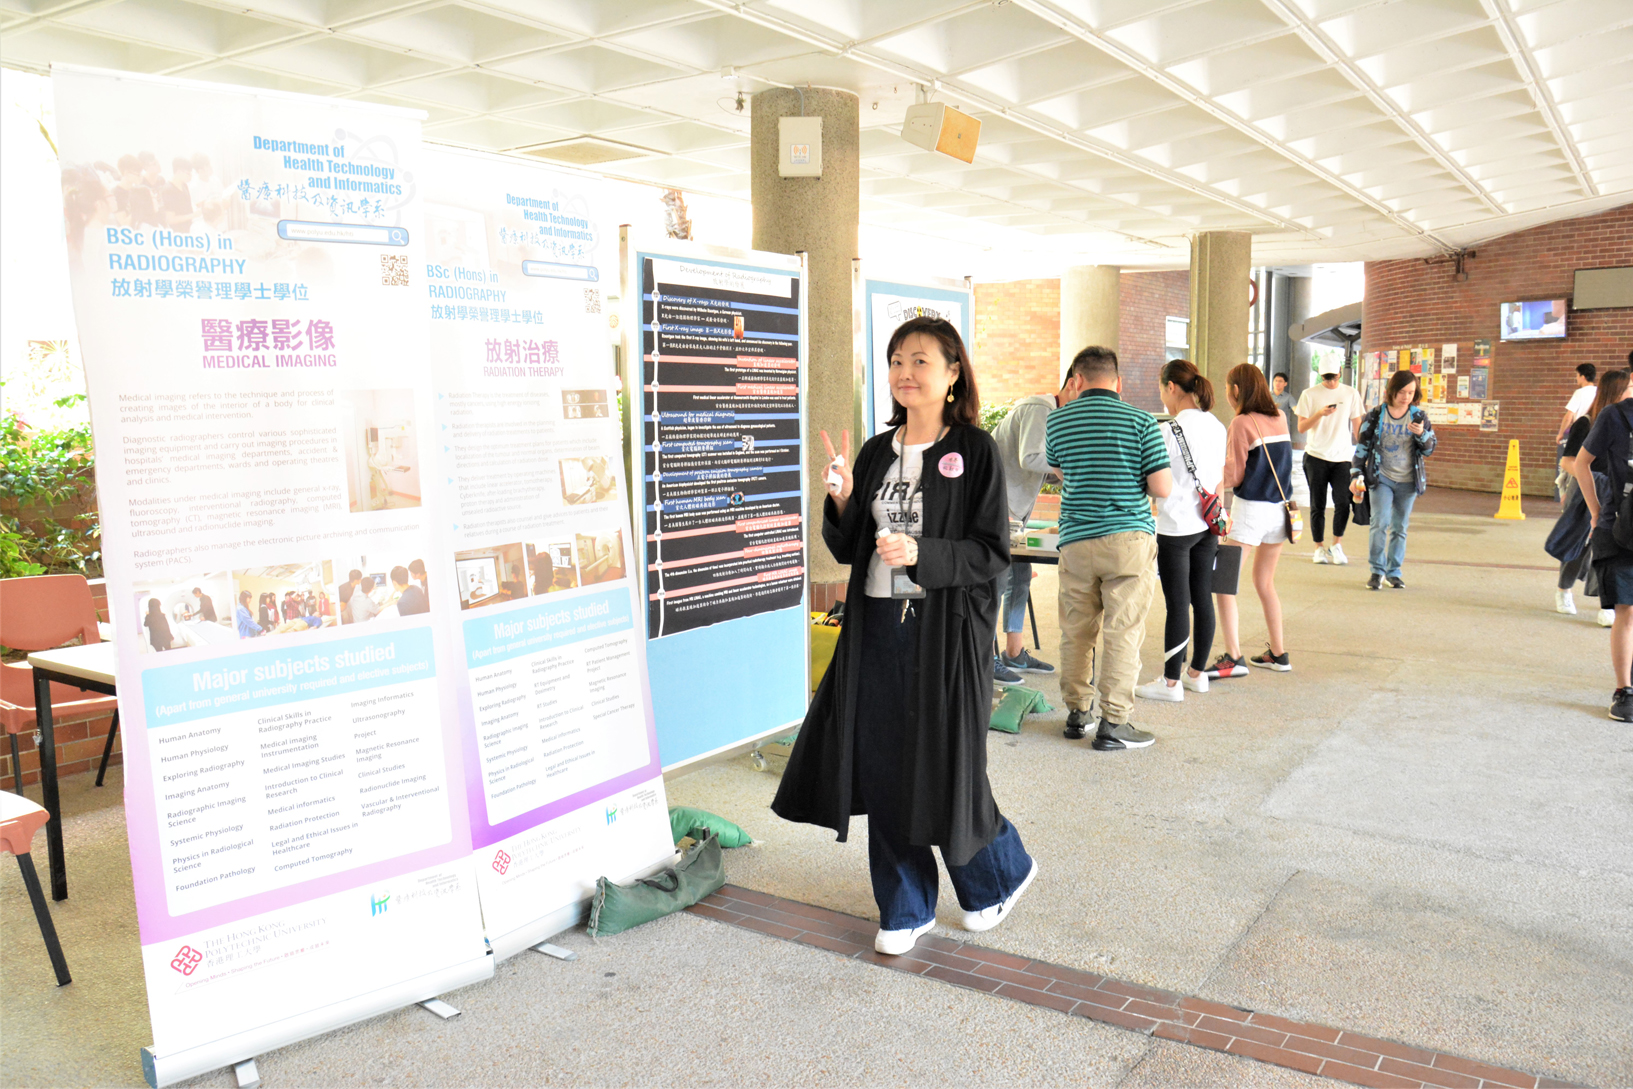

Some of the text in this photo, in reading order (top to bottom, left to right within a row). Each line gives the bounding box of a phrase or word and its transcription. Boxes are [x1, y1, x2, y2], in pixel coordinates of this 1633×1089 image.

[253, 136, 344, 158] Department of
[284, 156, 394, 180] Health Technology
[308, 176, 401, 195] and Informatics
[506, 194, 559, 212] Department of
[524, 209, 588, 229] Health Technology
[107, 228, 233, 252] BSc (Hons) in
[539, 226, 593, 241] and Informatics
[109, 254, 246, 274] RADIOGRAPHY
[427, 264, 499, 284] BSc (Hons) in
[680, 265, 771, 285] Development of Radiography
[112, 279, 309, 300] 放射學榮譽理學士學位
[429, 285, 506, 302] RADIOGRAPHY
[662, 295, 686, 304] Discovery
[693, 298, 708, 306] X-rays
[432, 305, 544, 324] 放射學榮譽理學士學位
[202, 319, 335, 351] 醫療影像
[203, 354, 336, 368] MEDICAL IMAGING
[486, 339, 559, 364] 放射治療
[483, 366, 564, 377] RADIATION THERAPY
[154, 394, 186, 402] imaging
[189, 392, 211, 400] refers
[240, 391, 278, 399] technique
[298, 390, 324, 398] process
[326, 388, 334, 396] of
[120, 412, 154, 424] analysis
[156, 414, 172, 422] and
[173, 412, 203, 420] medical
[494, 600, 609, 639] Major subjects studied
[193, 642, 395, 691] Major subjects studied
[475, 669, 512, 682] Human Anatomy
[156, 660, 429, 718] (Apart from general university required and elective subjects)
[477, 683, 517, 697] Human Physiology
[350, 692, 414, 708] Imaging Informatics
[479, 695, 526, 712] Exploring Radiography
[258, 715, 283, 725] Clinical
[285, 712, 303, 720] Skills
[258, 716, 332, 733] Radiography Practice
[352, 709, 405, 723] Ultrasonography
[159, 728, 221, 744] Human Anatomy
[260, 735, 318, 749] Medical imaging
[354, 730, 376, 739] Project
[161, 745, 228, 763] Human Physiology
[261, 743, 319, 758] Instrumentation
[356, 738, 420, 754] Magnetic Resonance
[263, 754, 346, 774] Medical Imaging Studies
[356, 753, 382, 763] Imaging
[163, 760, 245, 782] Exploring Radiography
[265, 778, 308, 790] Introduction
[319, 769, 344, 779] Clinical
[358, 764, 405, 778] Clinical Studies
[165, 782, 230, 800] Imaging Anatomy
[266, 788, 298, 799] Research
[360, 775, 426, 794] Radionuclide Imaging
[268, 796, 335, 815] Medical informatics
[361, 799, 388, 809] Vascular
[396, 786, 440, 800] Interventional
[167, 796, 246, 819] Radiographic Imaging
[362, 804, 401, 817] Radiography
[168, 817, 196, 828] Science
[270, 811, 340, 831] Radiation Protection
[170, 824, 243, 847] Systemic Physiology
[271, 838, 290, 848] Legal
[291, 834, 304, 843] and
[306, 829, 329, 839] Ethical
[330, 825, 350, 833] Issues
[172, 854, 200, 864] Physics
[210, 839, 254, 855] Radiological
[272, 843, 310, 856] Healthcare
[173, 862, 202, 874] Science
[274, 848, 353, 872] Computed Tomography
[176, 867, 255, 891] Foundation Pathology
[207, 945, 261, 967] 香港理工大學
[185, 978, 209, 988] Opening
[210, 972, 227, 980] Minds
[231, 964, 253, 974] Shaping
[263, 955, 280, 964] Future
